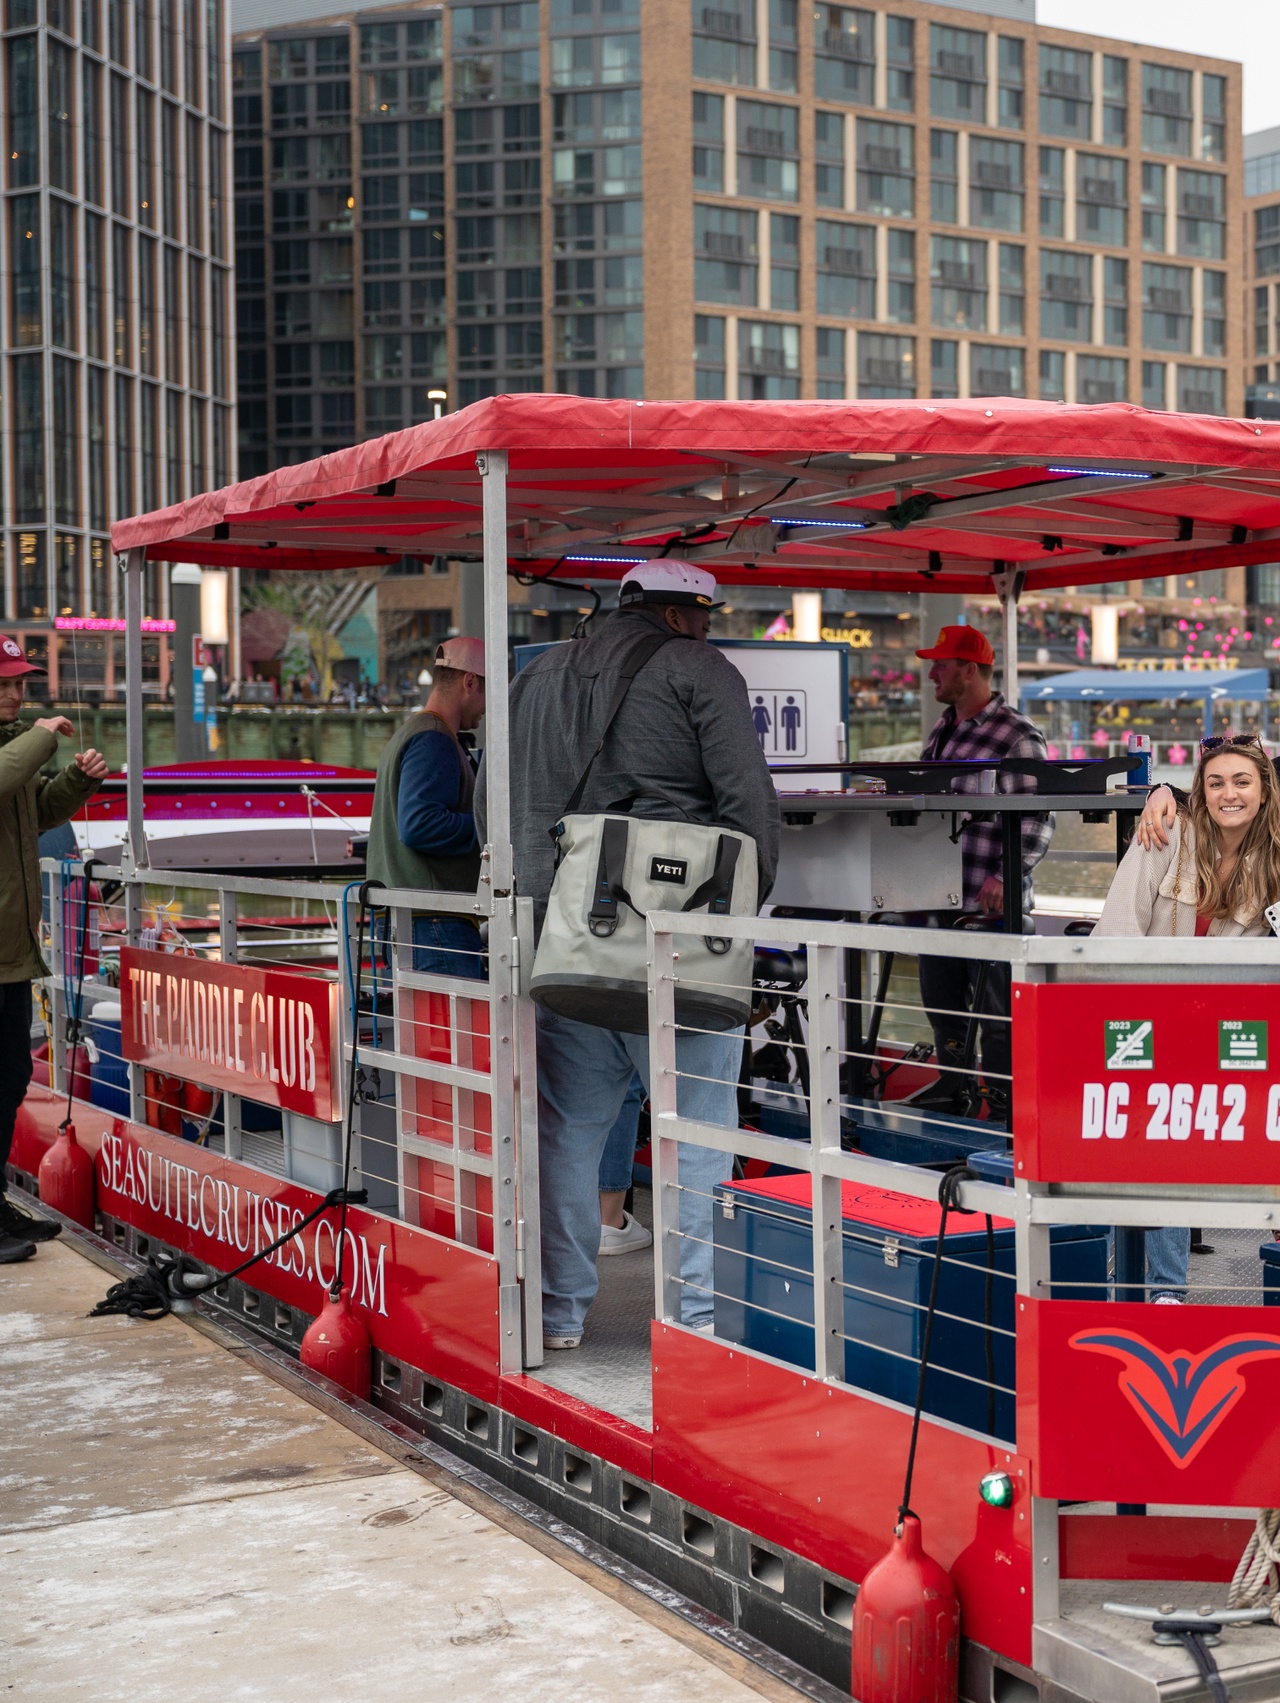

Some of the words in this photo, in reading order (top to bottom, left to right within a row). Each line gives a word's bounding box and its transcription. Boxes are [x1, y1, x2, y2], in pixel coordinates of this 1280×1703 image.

[655, 863, 683, 876] YETI
[128, 967, 163, 1050] THE
[166, 974, 246, 1074] PADDLE
[251, 991, 316, 1092] CLUB
[1108, 1021, 1131, 1031] 2023
[1222, 1021, 1243, 1031] 2023
[1082, 1082, 1130, 1139] DC
[1145, 1083, 1247, 1141] 2642
[101, 1131, 389, 1318] SEASUITECRUISES.COM
